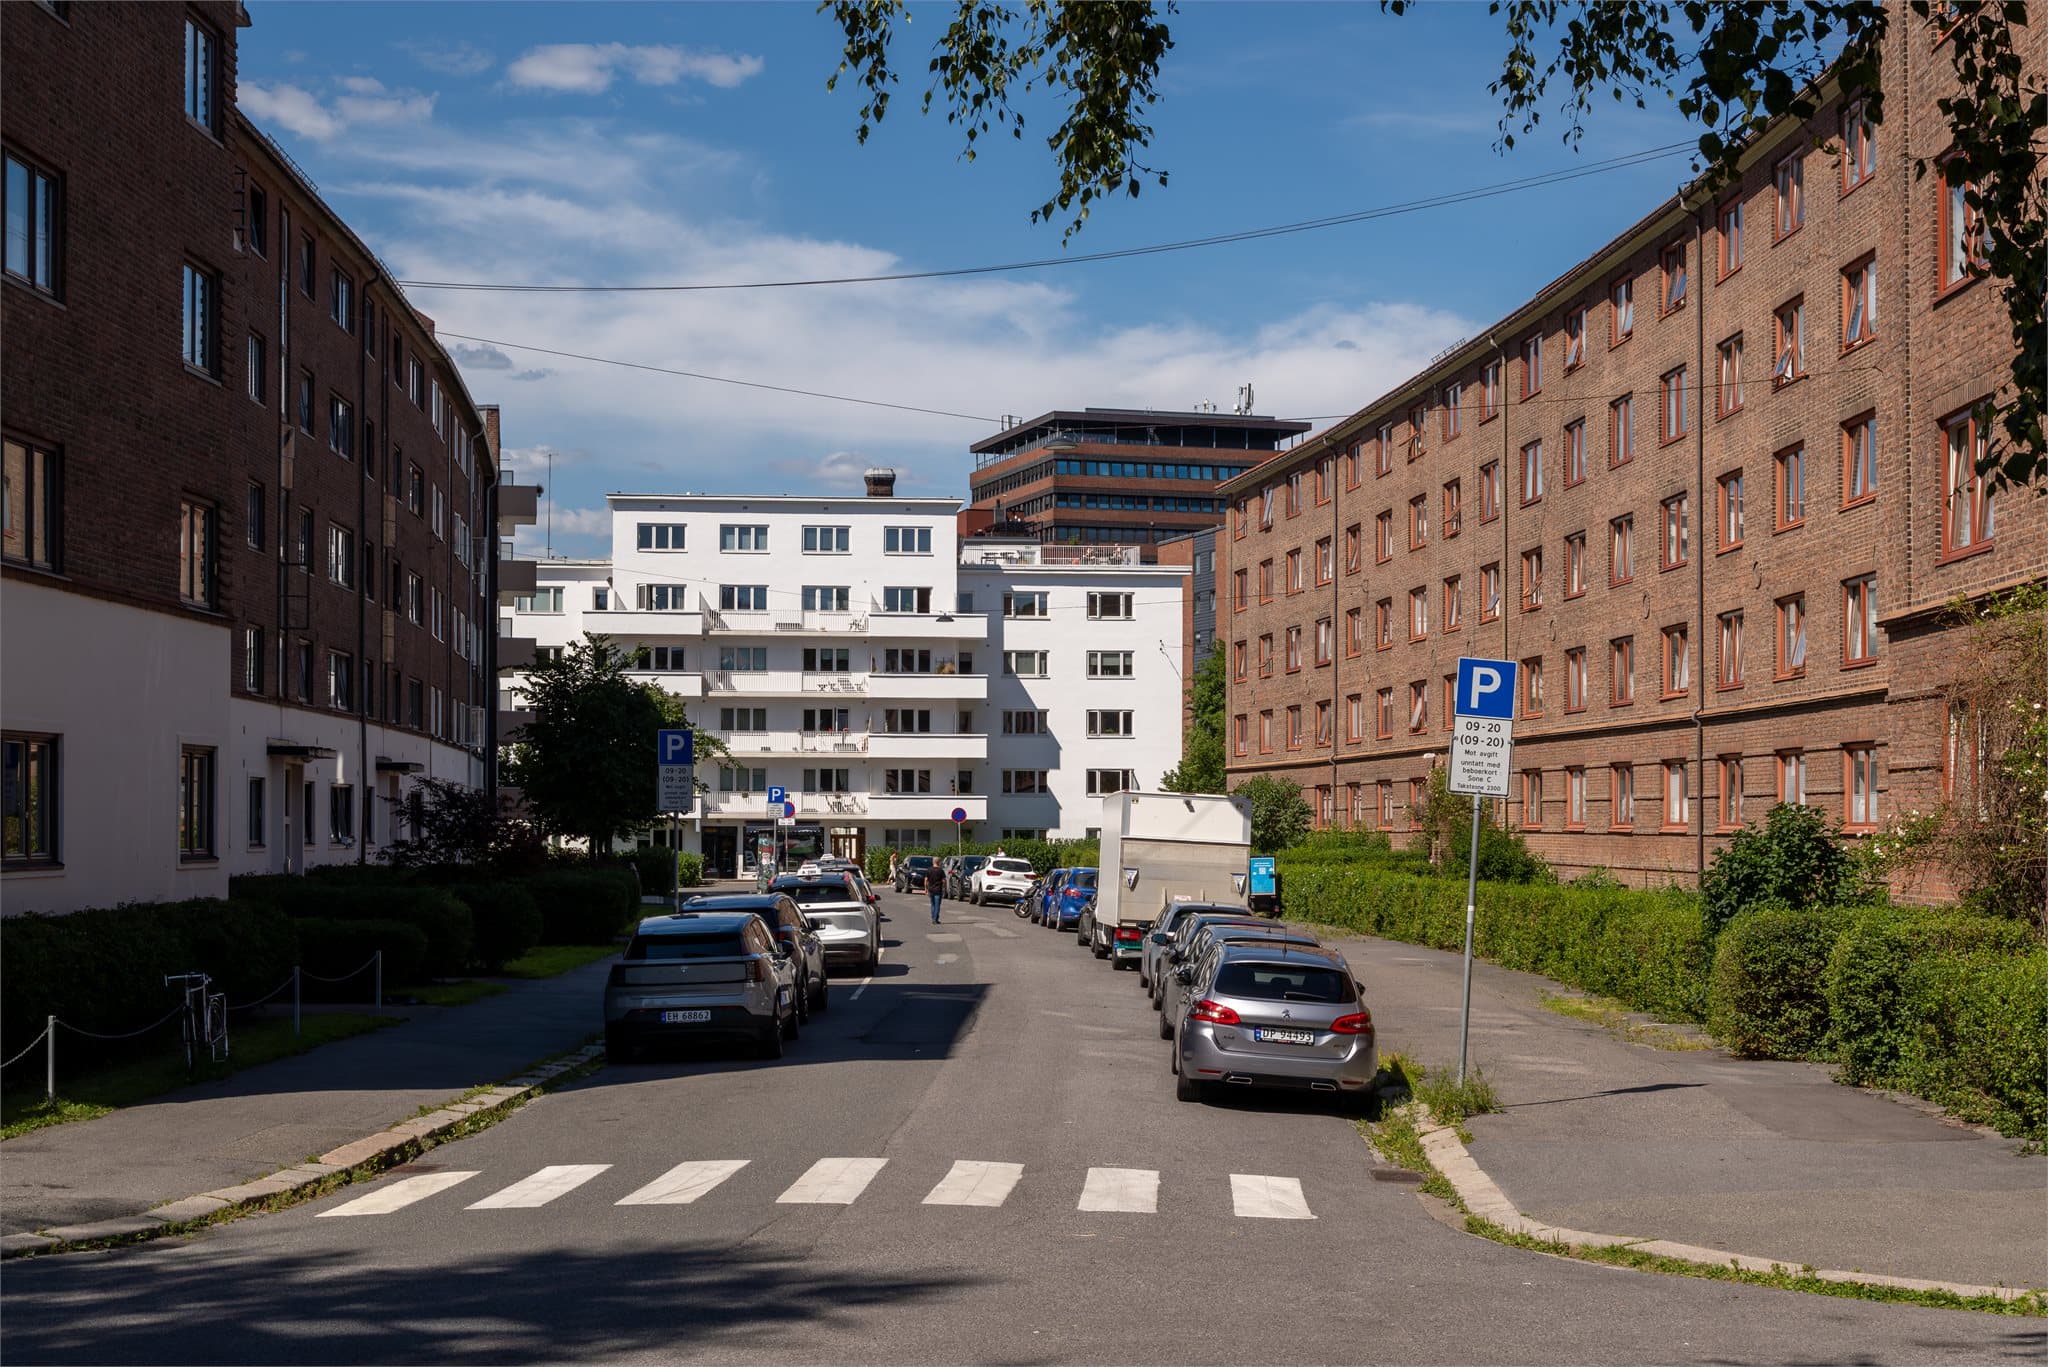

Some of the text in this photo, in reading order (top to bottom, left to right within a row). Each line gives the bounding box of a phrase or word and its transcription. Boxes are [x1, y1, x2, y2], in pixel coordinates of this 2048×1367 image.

[1470, 666, 1502, 709] P
[667, 734, 685, 761] P
[771, 788, 782, 802] P
[1262, 1028, 1276, 1038] DP
